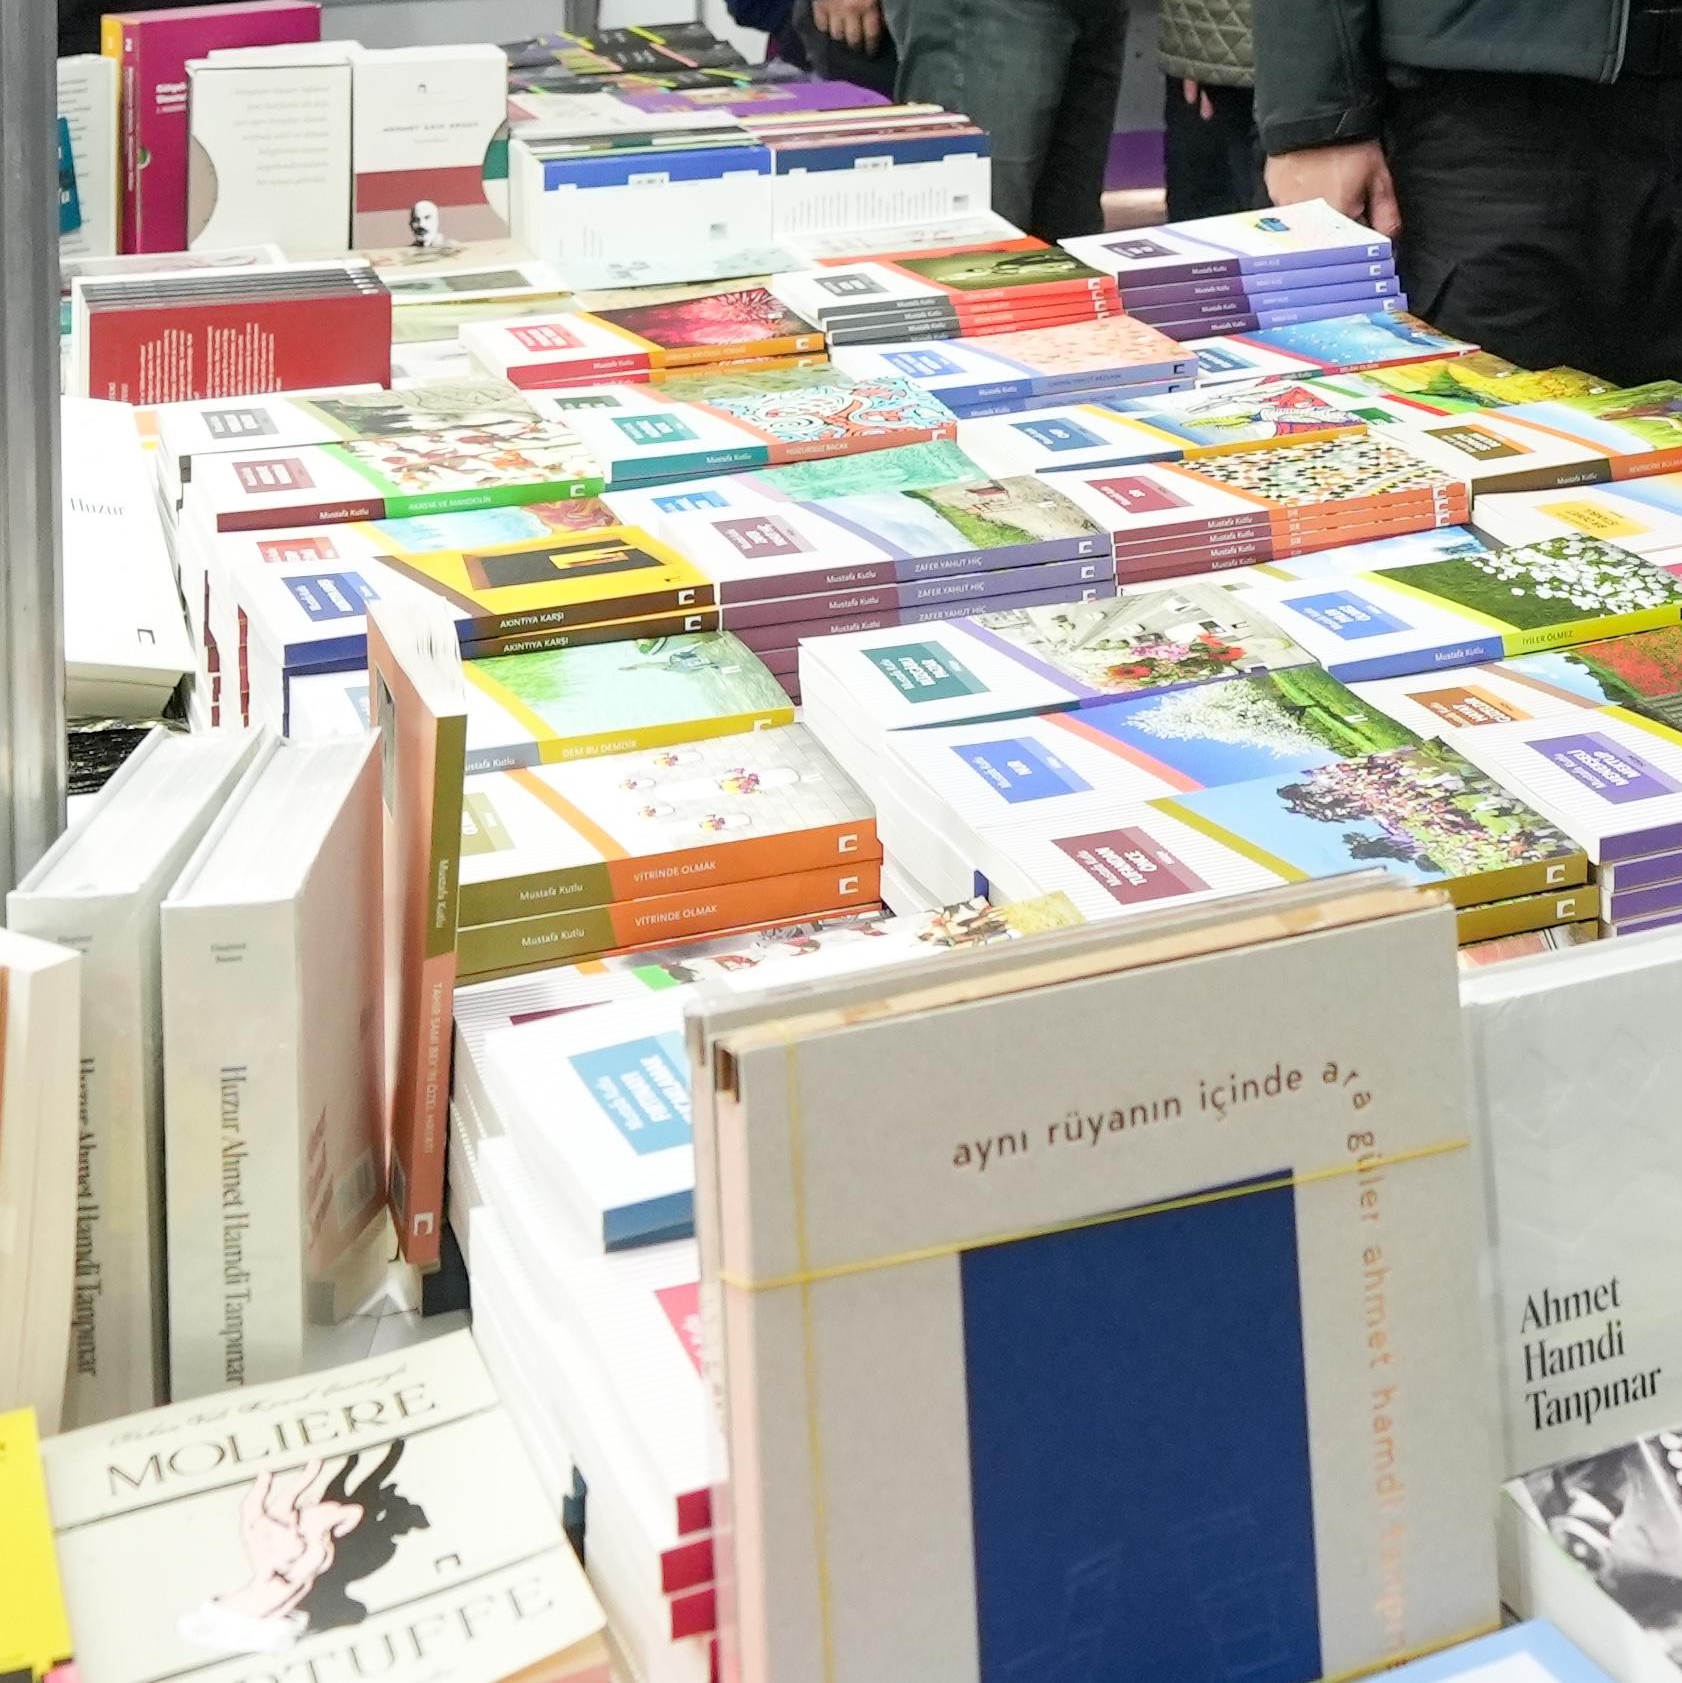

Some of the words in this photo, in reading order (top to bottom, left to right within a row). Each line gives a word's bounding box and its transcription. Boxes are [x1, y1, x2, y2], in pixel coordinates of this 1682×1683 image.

[826, 572, 855, 584] Mustafa
[856, 570, 877, 580] Kutlu
[829, 599, 858, 610] Mustafa
[860, 597, 880, 607] Kutlu
[830, 623, 860, 634] Mustafa
[861, 620, 881, 630] Kutlu
[1435, 650, 1465, 662] Mustafa
[1466, 646, 1485, 657] Kutlu
[520, 887, 557, 901] Mustafa
[558, 882, 583, 896] Kutlu
[633, 866, 679, 882] VİTRİNDE
[681, 860, 717, 875] OLMAK
[521, 931, 559, 948] Mustafa
[560, 927, 585, 941] Kutlu
[634, 911, 681, 927] VİTRİNDE
[682, 904, 718, 919] OLMAK
[221, 1065, 247, 1137] Huzur
[1199, 1063, 1304, 1120] içinde
[952, 1129, 1030, 1169] aynı
[1047, 1095, 1184, 1149] rüyanın
[221, 1137, 249, 1209] Ahmet
[1345, 1128, 1385, 1222] güler
[222, 1213, 252, 1287] Hamdi
[1362, 1247, 1391, 1371] ahmet
[1519, 1275, 1621, 1336] Ahmet
[218, 1287, 252, 1387] Tanpınar
[1523, 1319, 1627, 1384] Hamdi
[1525, 1365, 1663, 1434] Tanpınar
